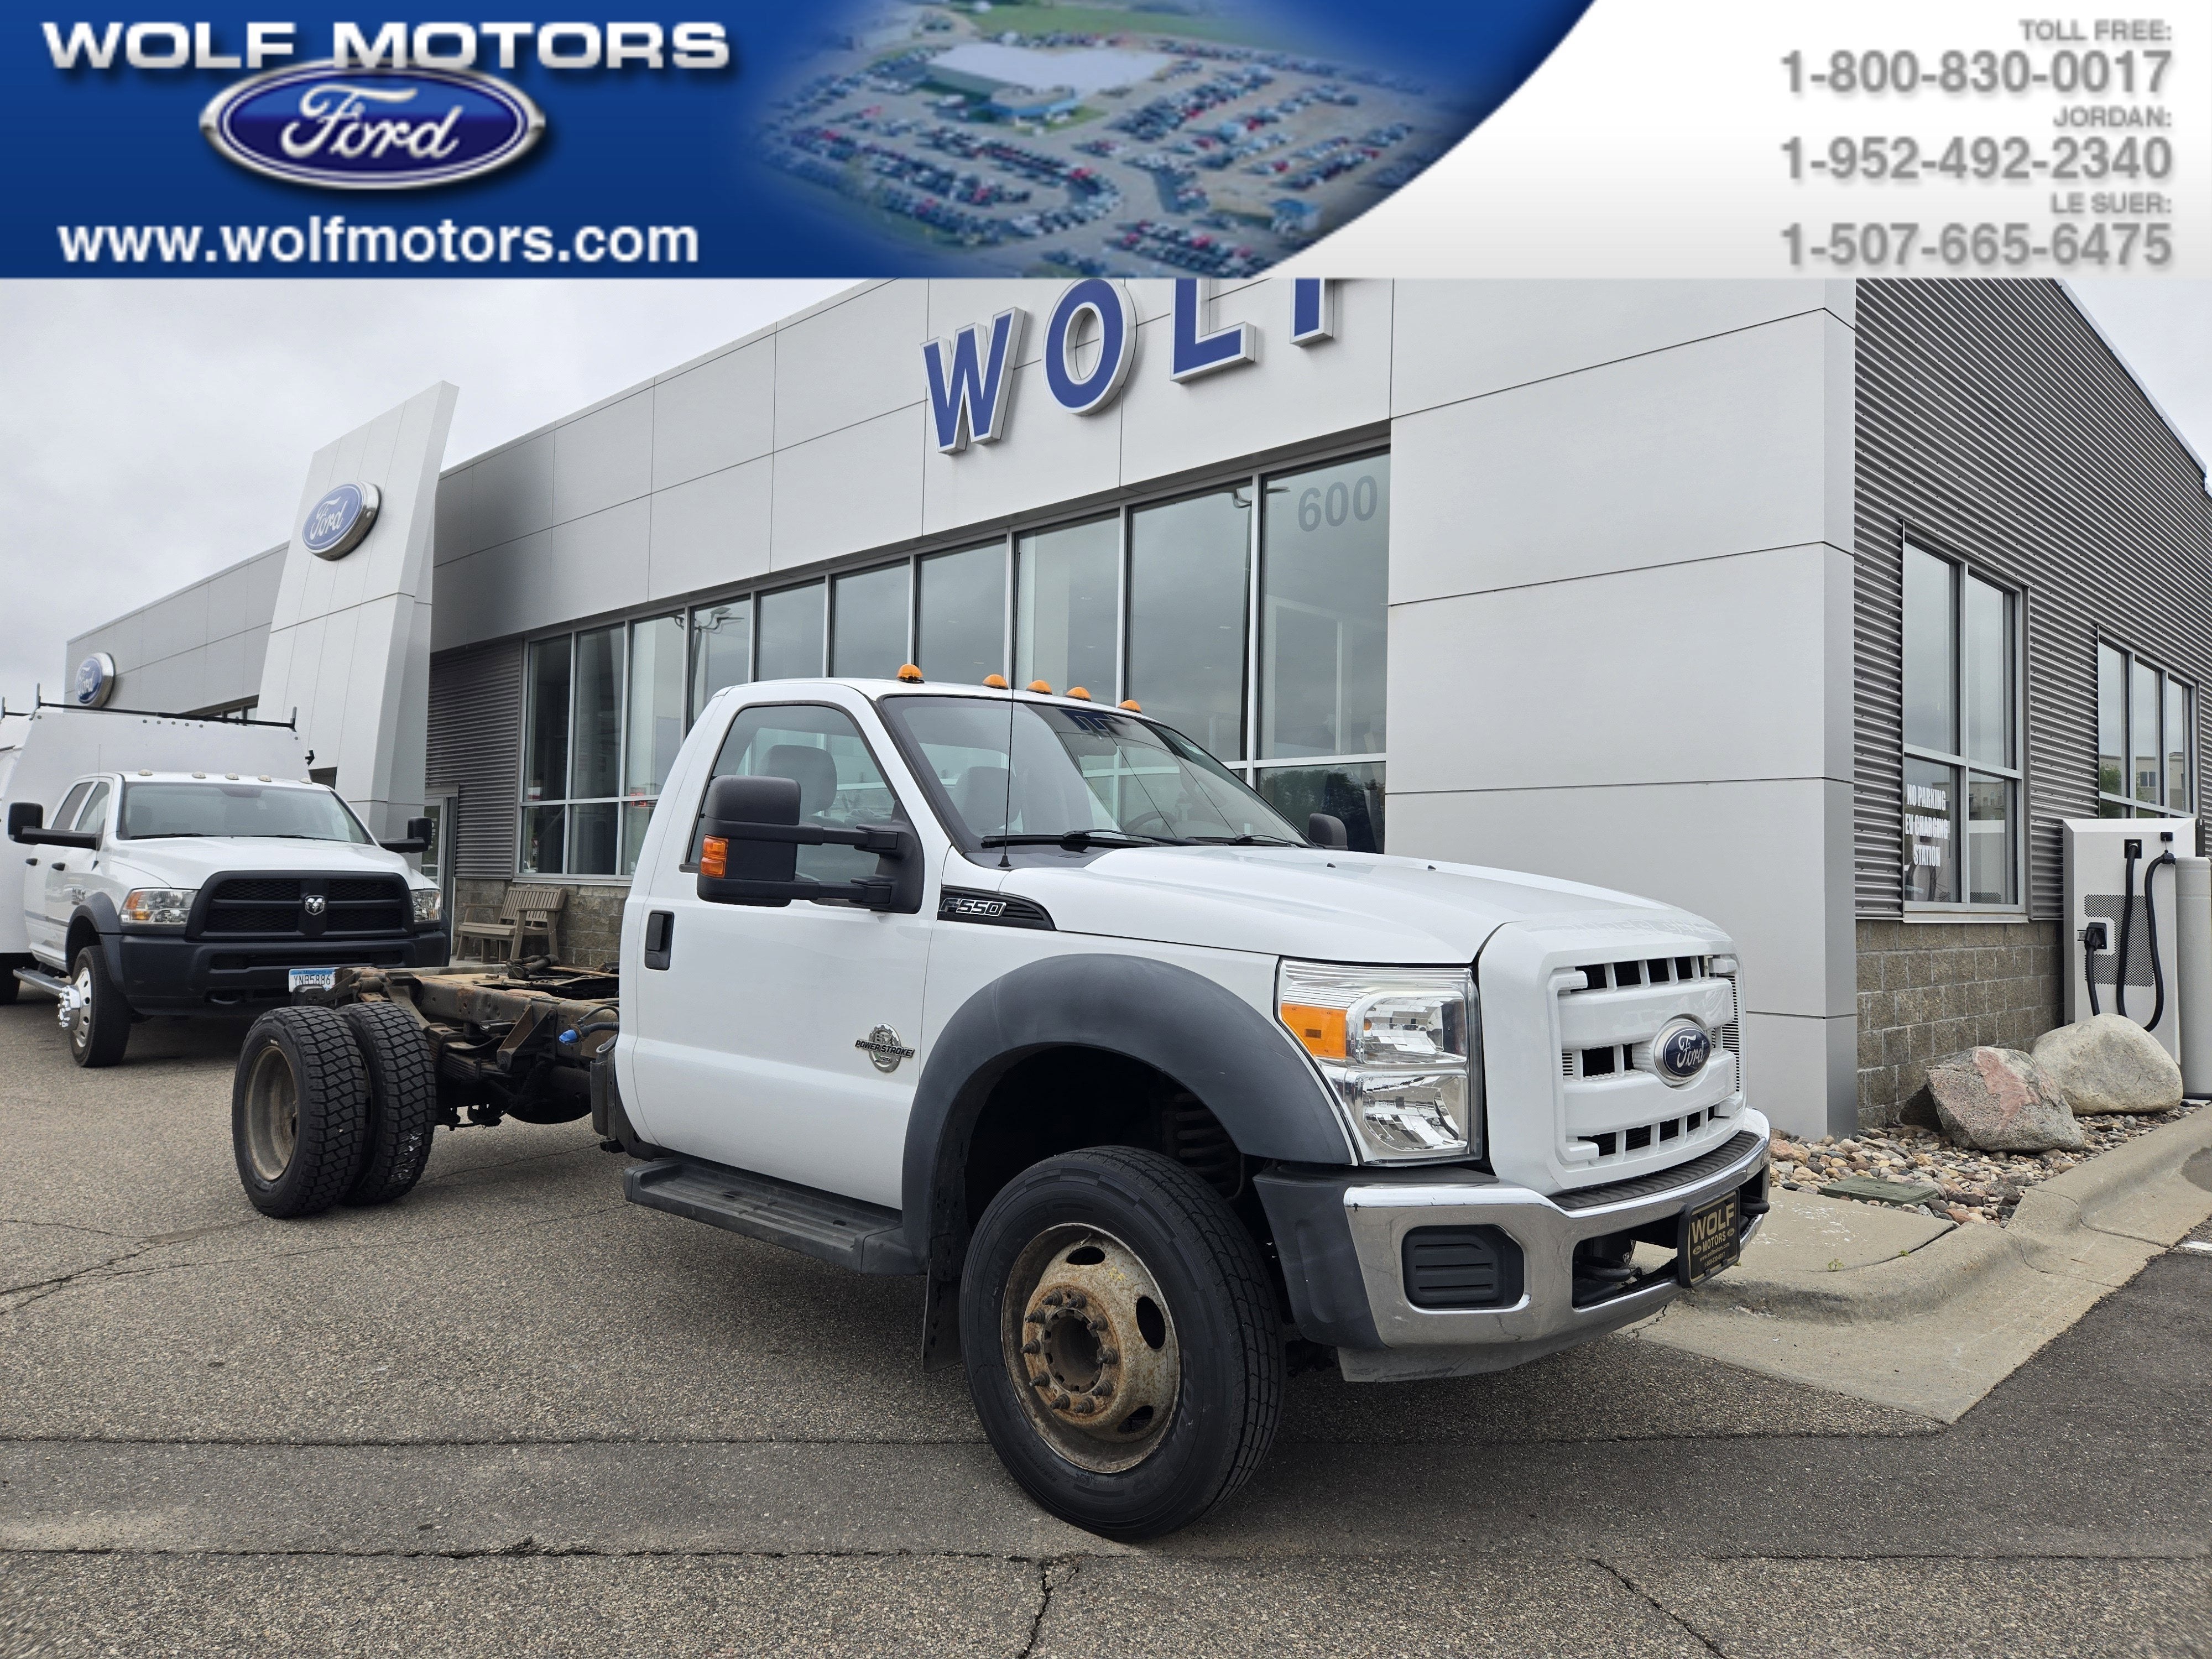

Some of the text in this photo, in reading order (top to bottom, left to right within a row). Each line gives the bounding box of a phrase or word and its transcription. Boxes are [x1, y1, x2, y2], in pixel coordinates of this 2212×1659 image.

[1297, 475, 1378, 533] 600
[310, 496, 349, 540] Ford
[1907, 784, 1946, 811] NO PARKING
[1905, 813, 1948, 839] EV CHARGING
[1913, 844, 1941, 867] STATION
[855, 1040, 913, 1057] POWER STROKE
[1677, 1034, 1707, 1068] Ford
[1692, 1202, 1734, 1244] WOLF
[1703, 1230, 1726, 1252] MOTORS
